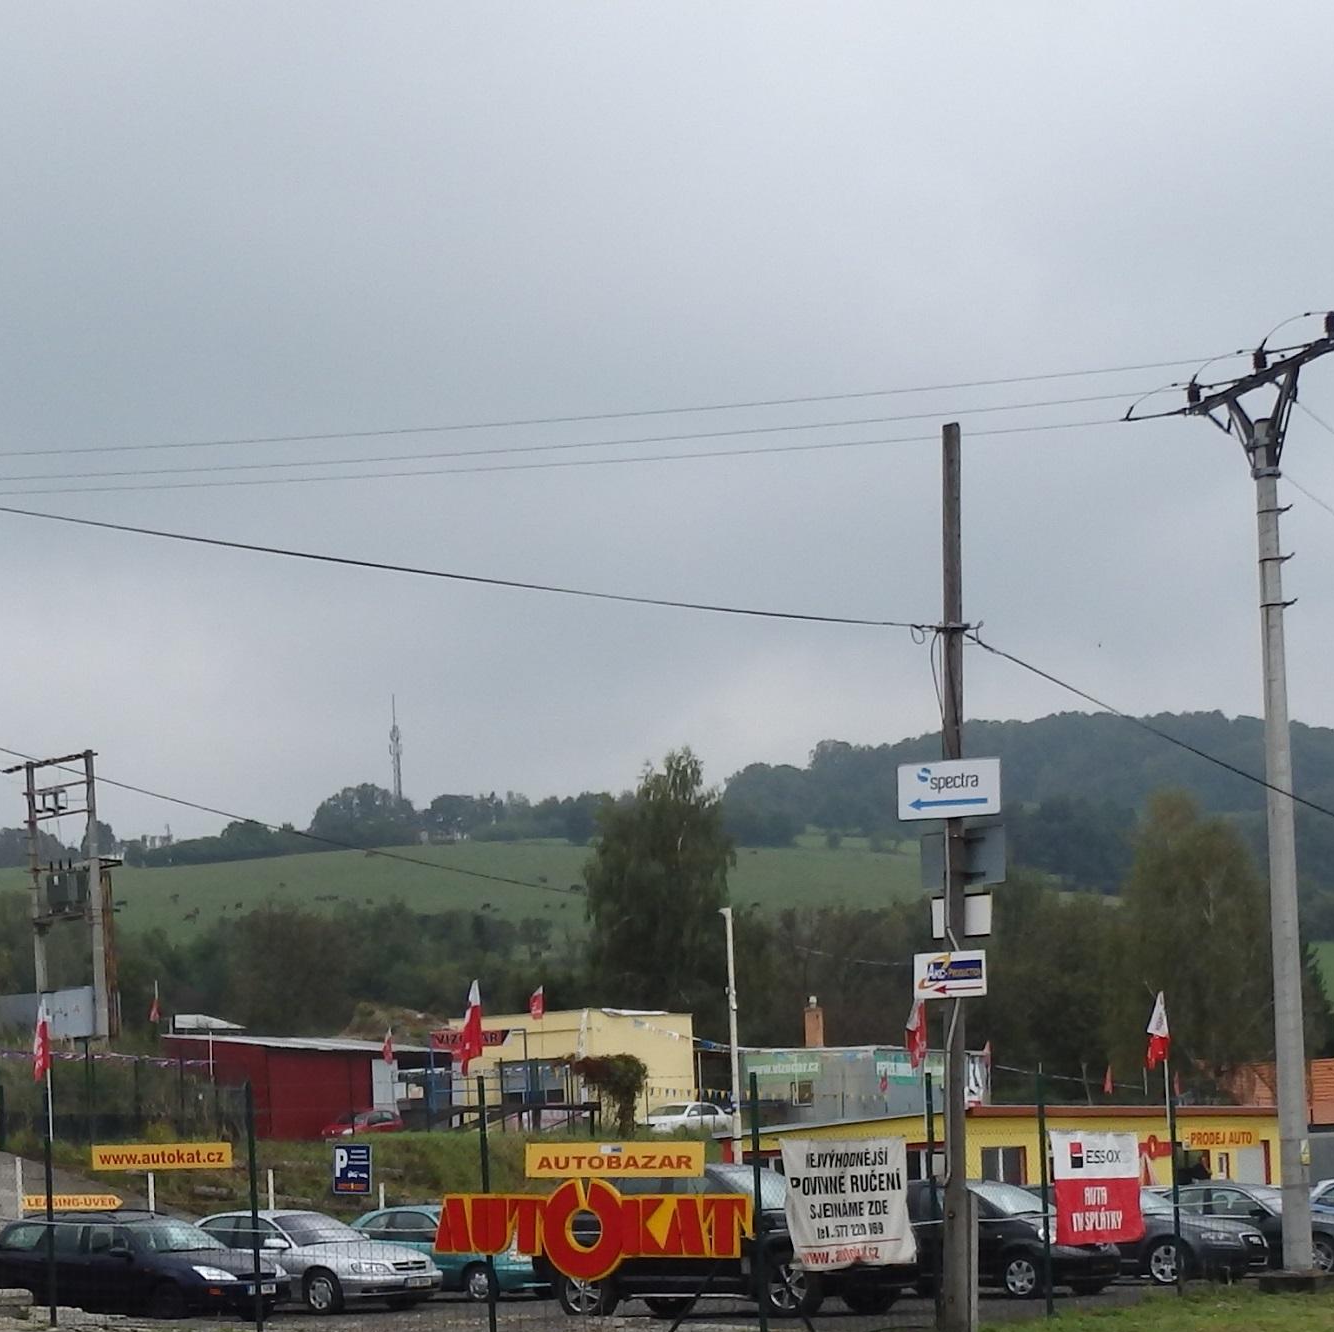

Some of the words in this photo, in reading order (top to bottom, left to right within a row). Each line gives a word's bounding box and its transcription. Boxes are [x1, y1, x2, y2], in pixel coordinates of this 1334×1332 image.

[930, 773, 979, 794] spectra
[1190, 1131, 1226, 1146] PRODEJ
[1228, 1131, 1253, 1145] AUTO
[99, 1148, 225, 1165] www.autokat.cz
[335, 1148, 348, 1178] P
[536, 1154, 693, 1171] AUTOBAZAR
[1086, 1149, 1122, 1164] ESSOX
[850, 1168, 902, 1193] RUČENÍ
[1084, 1186, 1108, 1206] AUTA
[867, 1200, 889, 1216] ZDE
[434, 1177, 754, 1282] AUTOKAT
